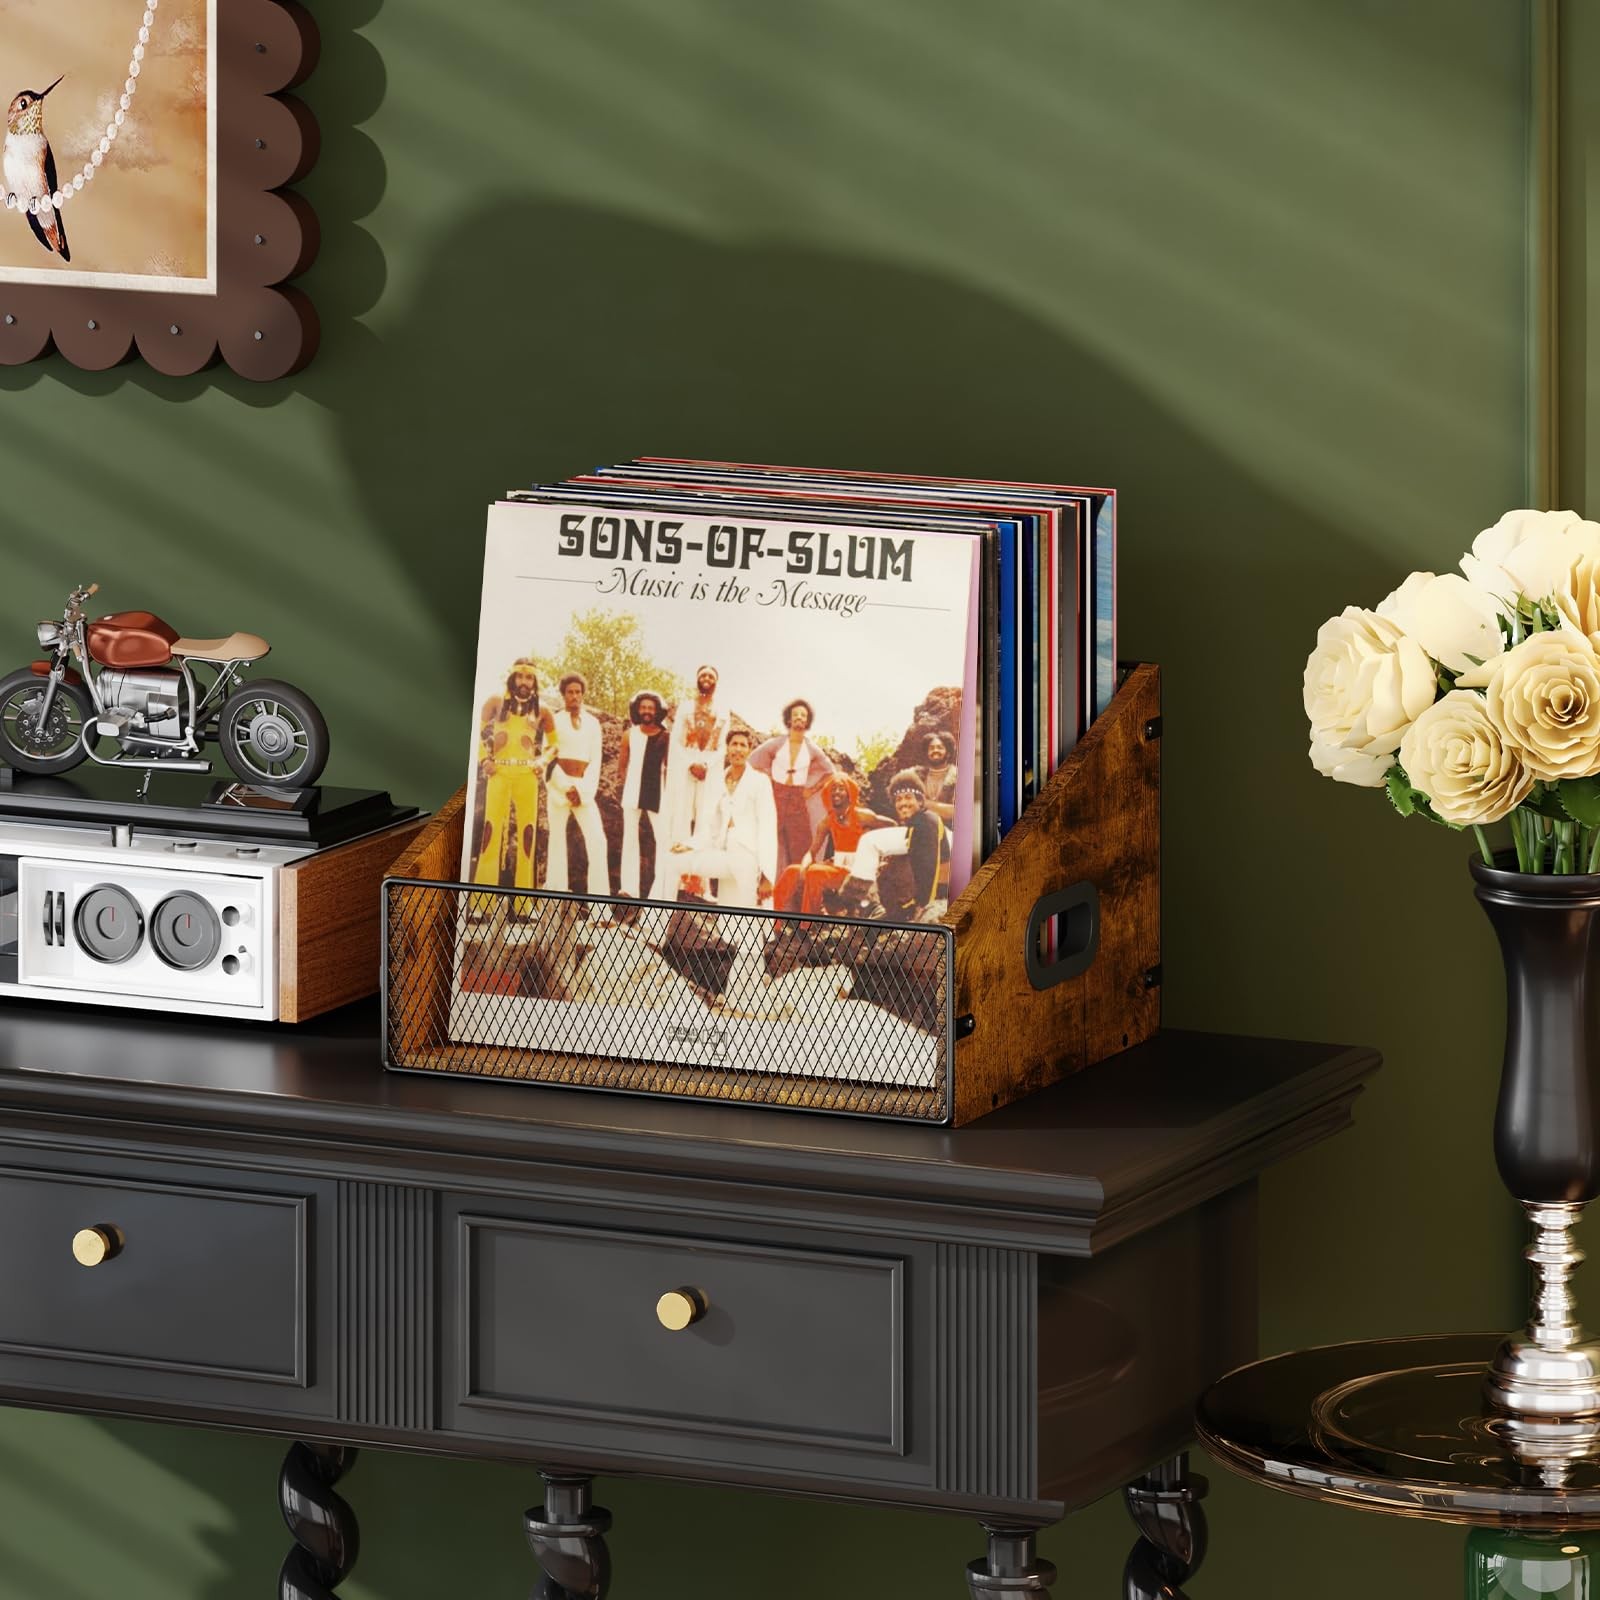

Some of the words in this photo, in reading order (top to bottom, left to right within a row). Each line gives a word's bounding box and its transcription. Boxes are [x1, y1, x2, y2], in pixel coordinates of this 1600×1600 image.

[558, 514, 915, 582] SONS-OF-SLUM
[596, 567, 684, 597] Music
[690, 572, 709, 600] is
[715, 575, 750, 604] the
[756, 579, 867, 618] Message
